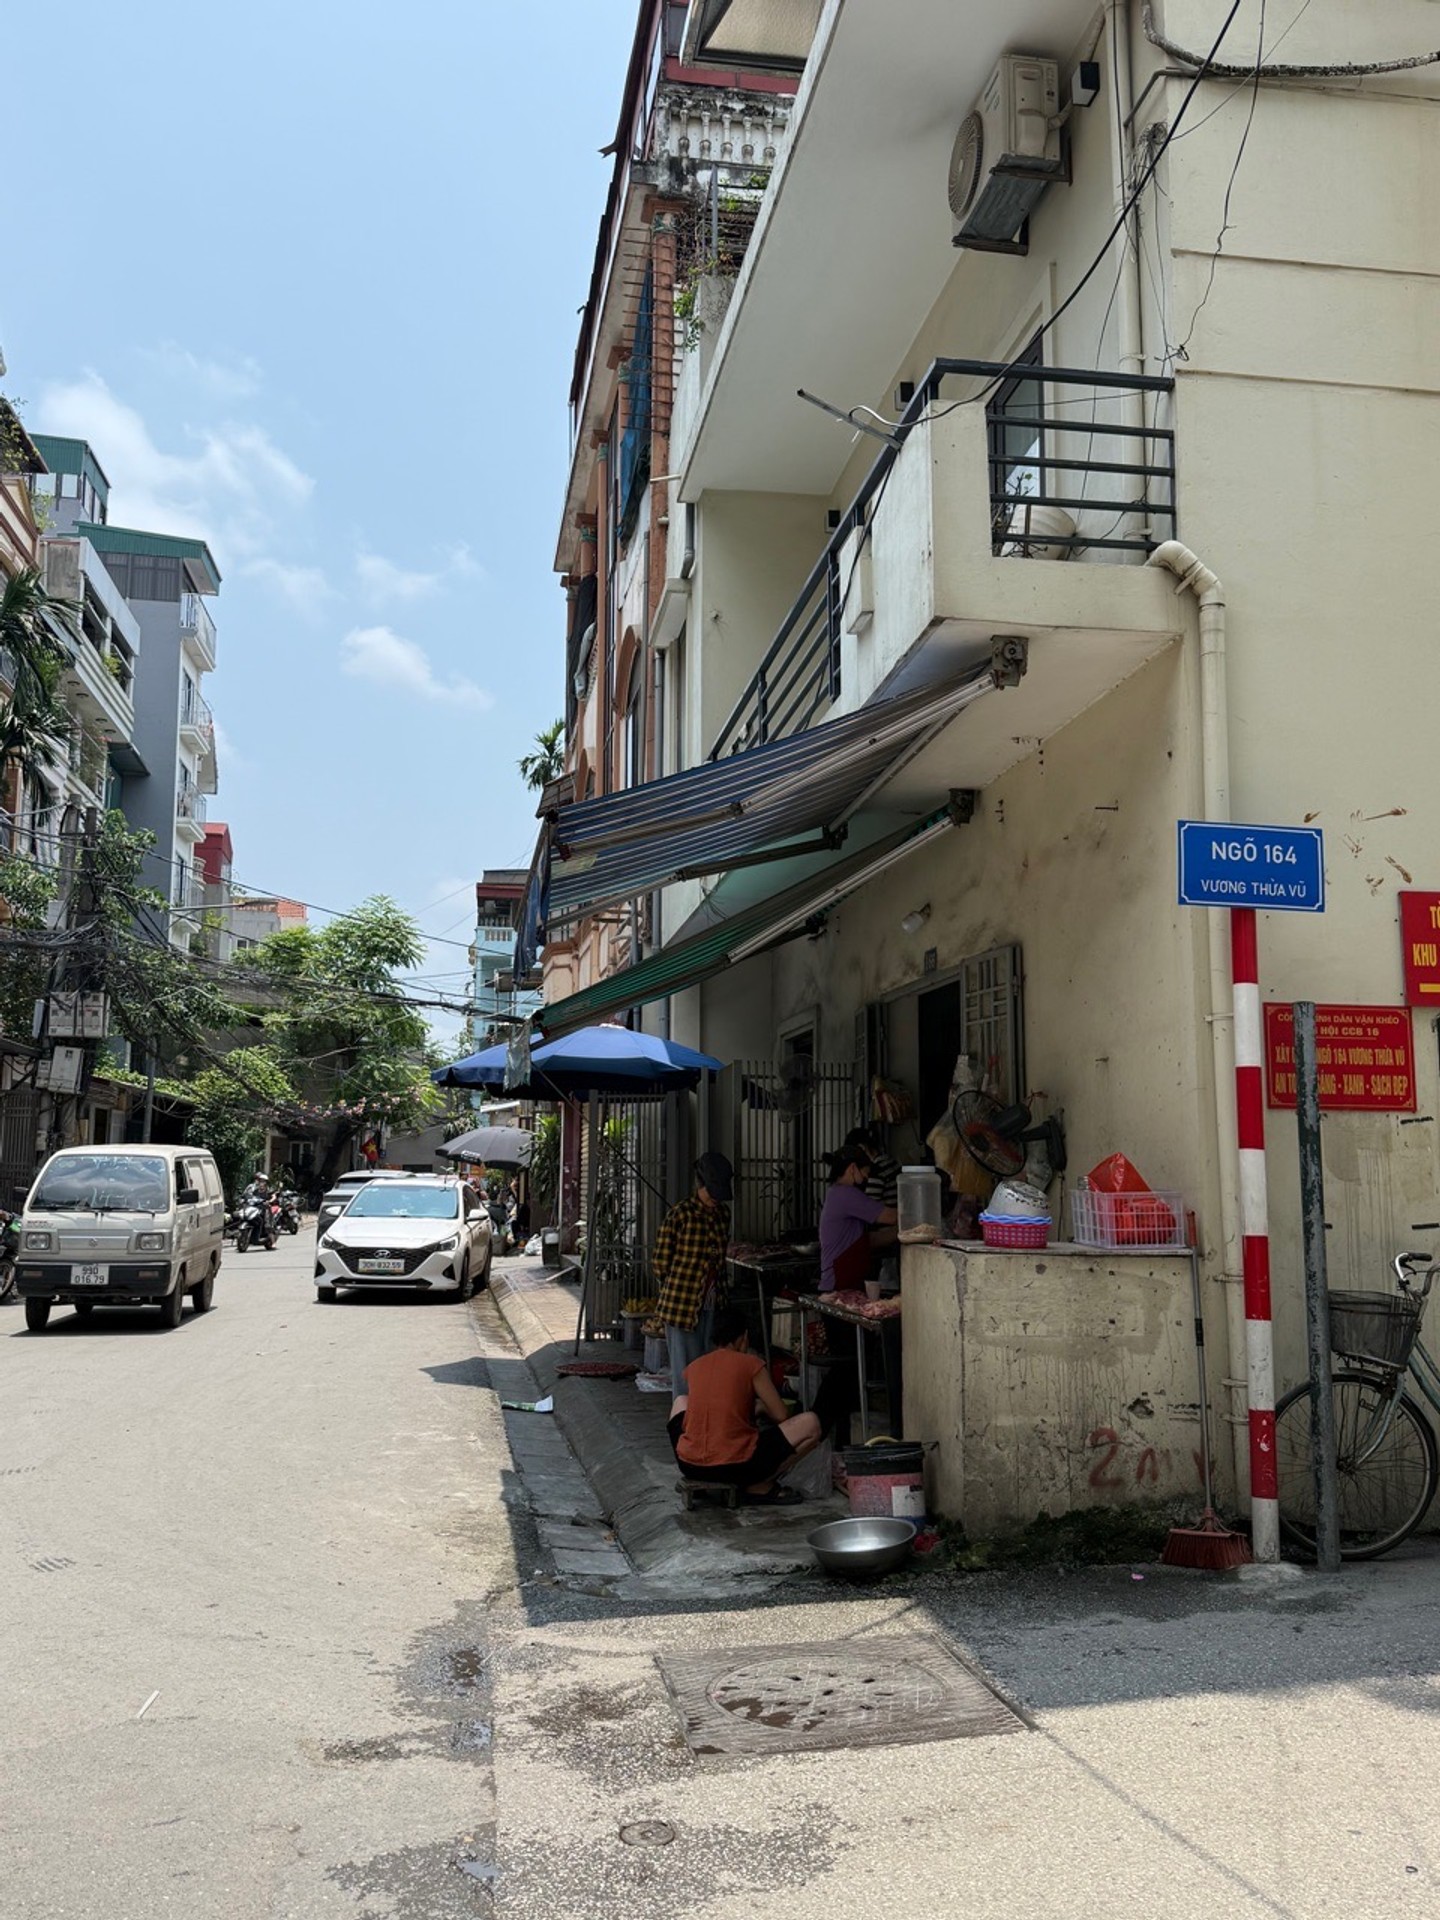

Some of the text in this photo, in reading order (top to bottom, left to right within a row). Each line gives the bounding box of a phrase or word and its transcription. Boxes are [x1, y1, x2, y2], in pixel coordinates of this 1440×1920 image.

[1211, 837, 1297, 864] NGÕ 164
[1200, 878, 1307, 898] VƯƠNG THỪA VŨ
[1413, 943, 1438, 967] KHU
[1320, 1025, 1339, 1037] HỘI
[1341, 1026, 1364, 1037] CCB
[1333, 1013, 1353, 1024] DÂN
[1354, 1014, 1374, 1026] VẬN
[1375, 1015, 1400, 1025] KHÉO
[1275, 1042, 1290, 1064] XÂY
[1333, 1047, 1347, 1065] 164
[1347, 1047, 1374, 1066] VƯƠNG
[1394, 1045, 1406, 1066] VŨ
[1275, 1072, 1287, 1094] AN
[1342, 1073, 1365, 1096] XANH
[1370, 1074, 1392, 1100] SẠCH
